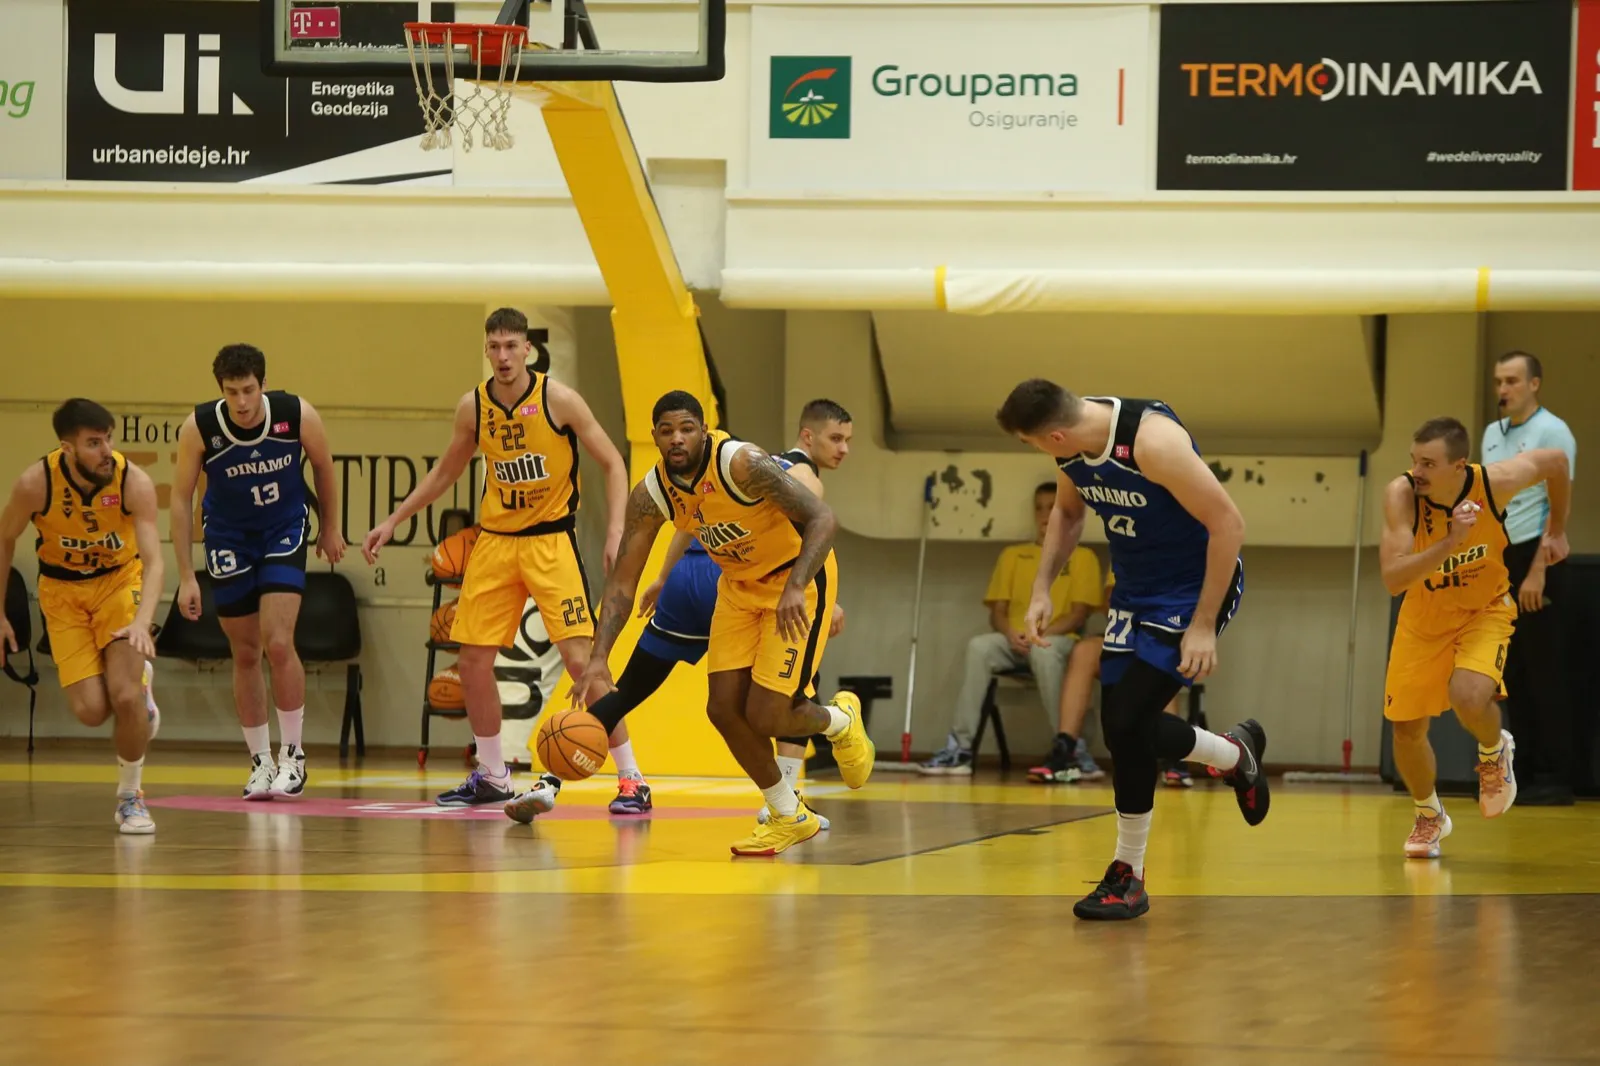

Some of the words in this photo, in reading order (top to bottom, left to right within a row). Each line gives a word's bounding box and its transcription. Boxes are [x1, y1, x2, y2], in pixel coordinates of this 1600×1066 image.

[311, 81, 395, 99] Energetika
[872, 65, 1078, 104] Groupama
[311, 101, 389, 118] Geodezija
[969, 110, 1078, 130] Osiguranje
[92, 145, 250, 168] urbaneideje.hr
[1185, 153, 1298, 165] termodinamika.hr
[1426, 150, 1543, 164] #wedeliverquality
[500, 423, 527, 451] 22
[225, 453, 292, 478] DINAMO
[493, 453, 550, 484] split
[250, 482, 280, 506] 13
[83, 511, 99, 533] 5
[209, 549, 238, 576] 13
[560, 595, 588, 628] 22
[1104, 609, 1135, 645] 27
[778, 647, 799, 679] 3
